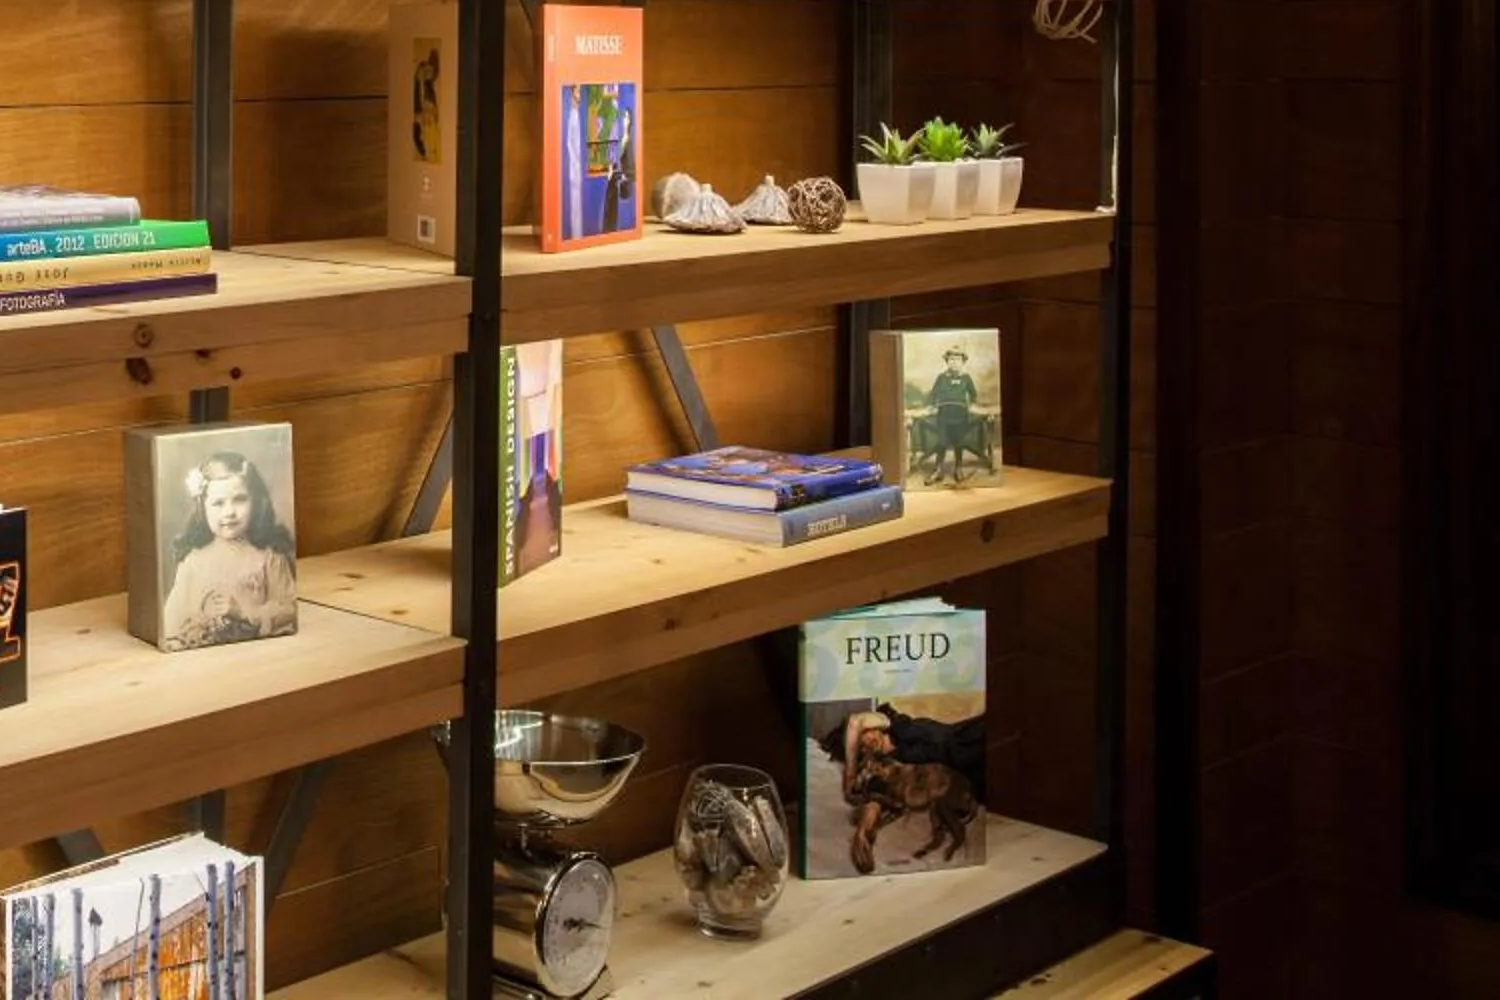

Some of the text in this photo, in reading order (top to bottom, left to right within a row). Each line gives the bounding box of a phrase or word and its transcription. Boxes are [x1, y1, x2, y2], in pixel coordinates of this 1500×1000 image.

[575, 34, 622, 56] MATISSE
[56, 235, 85, 252] 2012
[143, 230, 157, 246] 21
[505, 357, 516, 576] SPANISH DESIGN
[845, 632, 951, 665] FREUD
